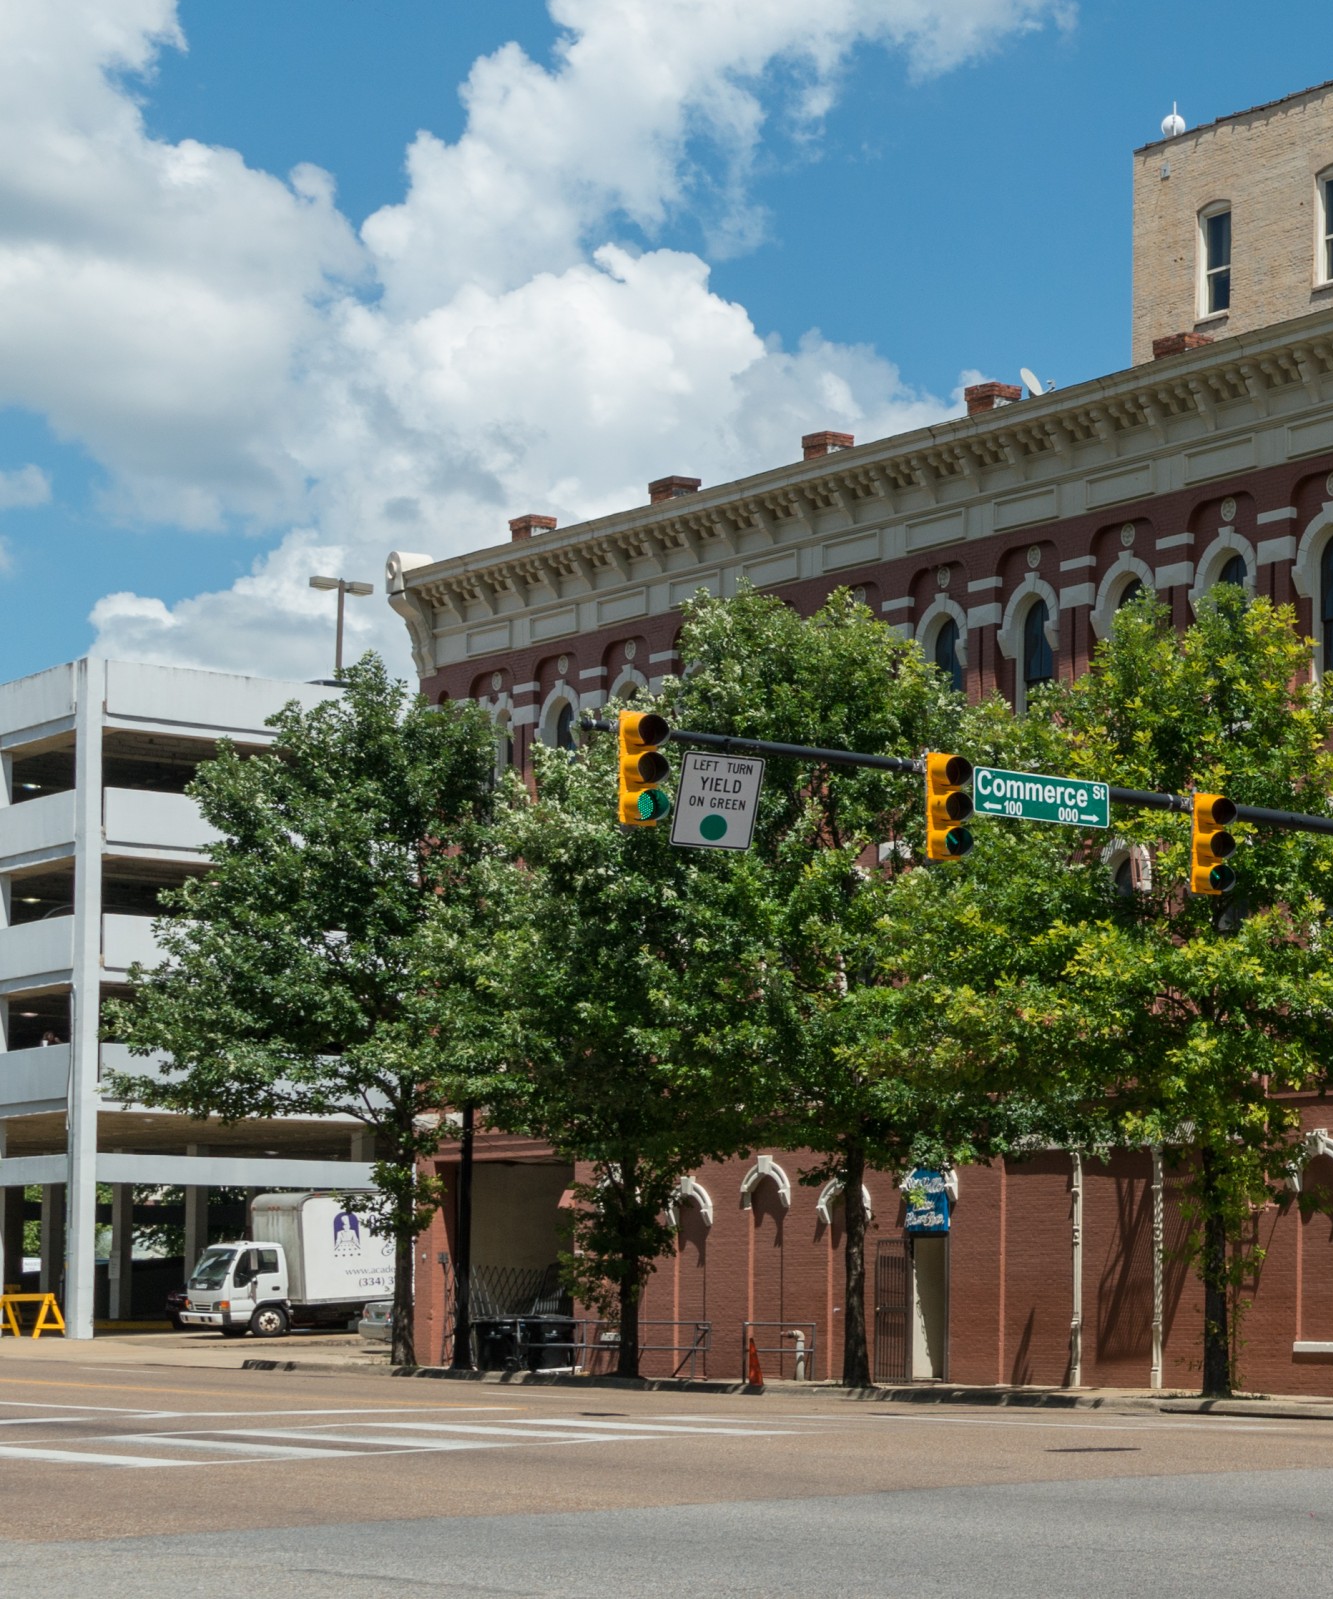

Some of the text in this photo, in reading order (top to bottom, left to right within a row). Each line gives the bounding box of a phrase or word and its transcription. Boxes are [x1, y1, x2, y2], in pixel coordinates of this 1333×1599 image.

[693, 759, 754, 775] LEFT TURN
[700, 776, 742, 794] YIELD
[977, 770, 1106, 807] Commerce St
[689, 795, 746, 811] ON GREEN
[1003, 800, 1079, 823] 100 000
[358, 1277, 385, 1288] (334)
